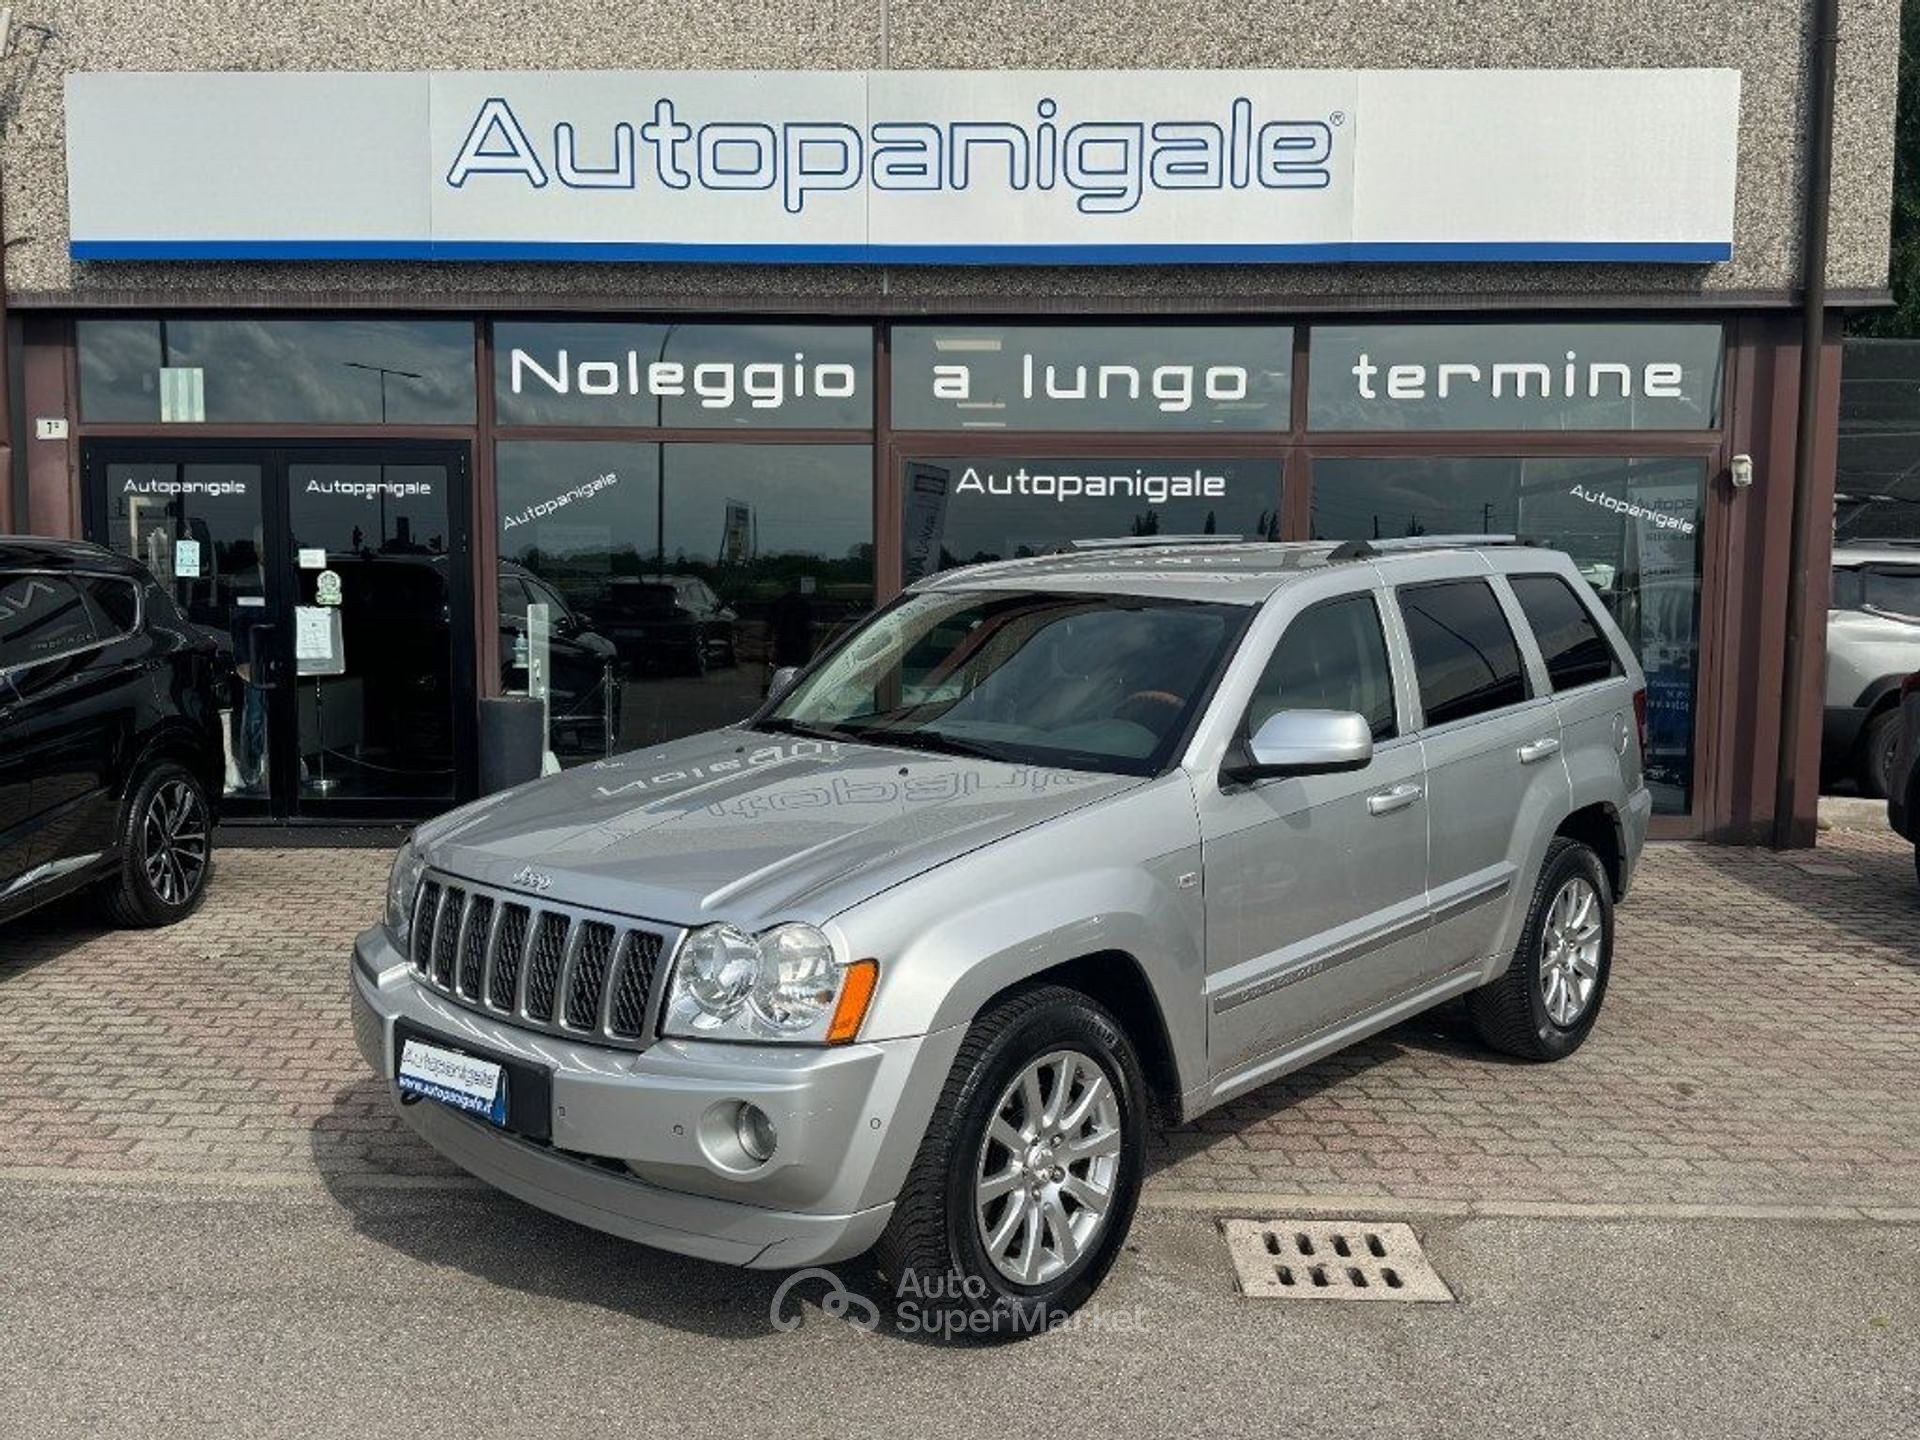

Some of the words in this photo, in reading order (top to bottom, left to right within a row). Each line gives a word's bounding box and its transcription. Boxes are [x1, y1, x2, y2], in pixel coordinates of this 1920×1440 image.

[511, 349, 855, 408] Noleggio
[933, 365, 970, 399] a
[1023, 353, 1247, 412] lungo
[1352, 350, 1683, 399] termine
[123, 478, 246, 496] Autopanigale
[305, 479, 431, 498] Autopanigale
[504, 472, 617, 531] Autopanigale
[955, 468, 1226, 503] Autopanigale
[1569, 484, 1694, 534] Autopanigale
[512, 866, 553, 892] Jeep
[402, 1048, 497, 1089] Autopanigale
